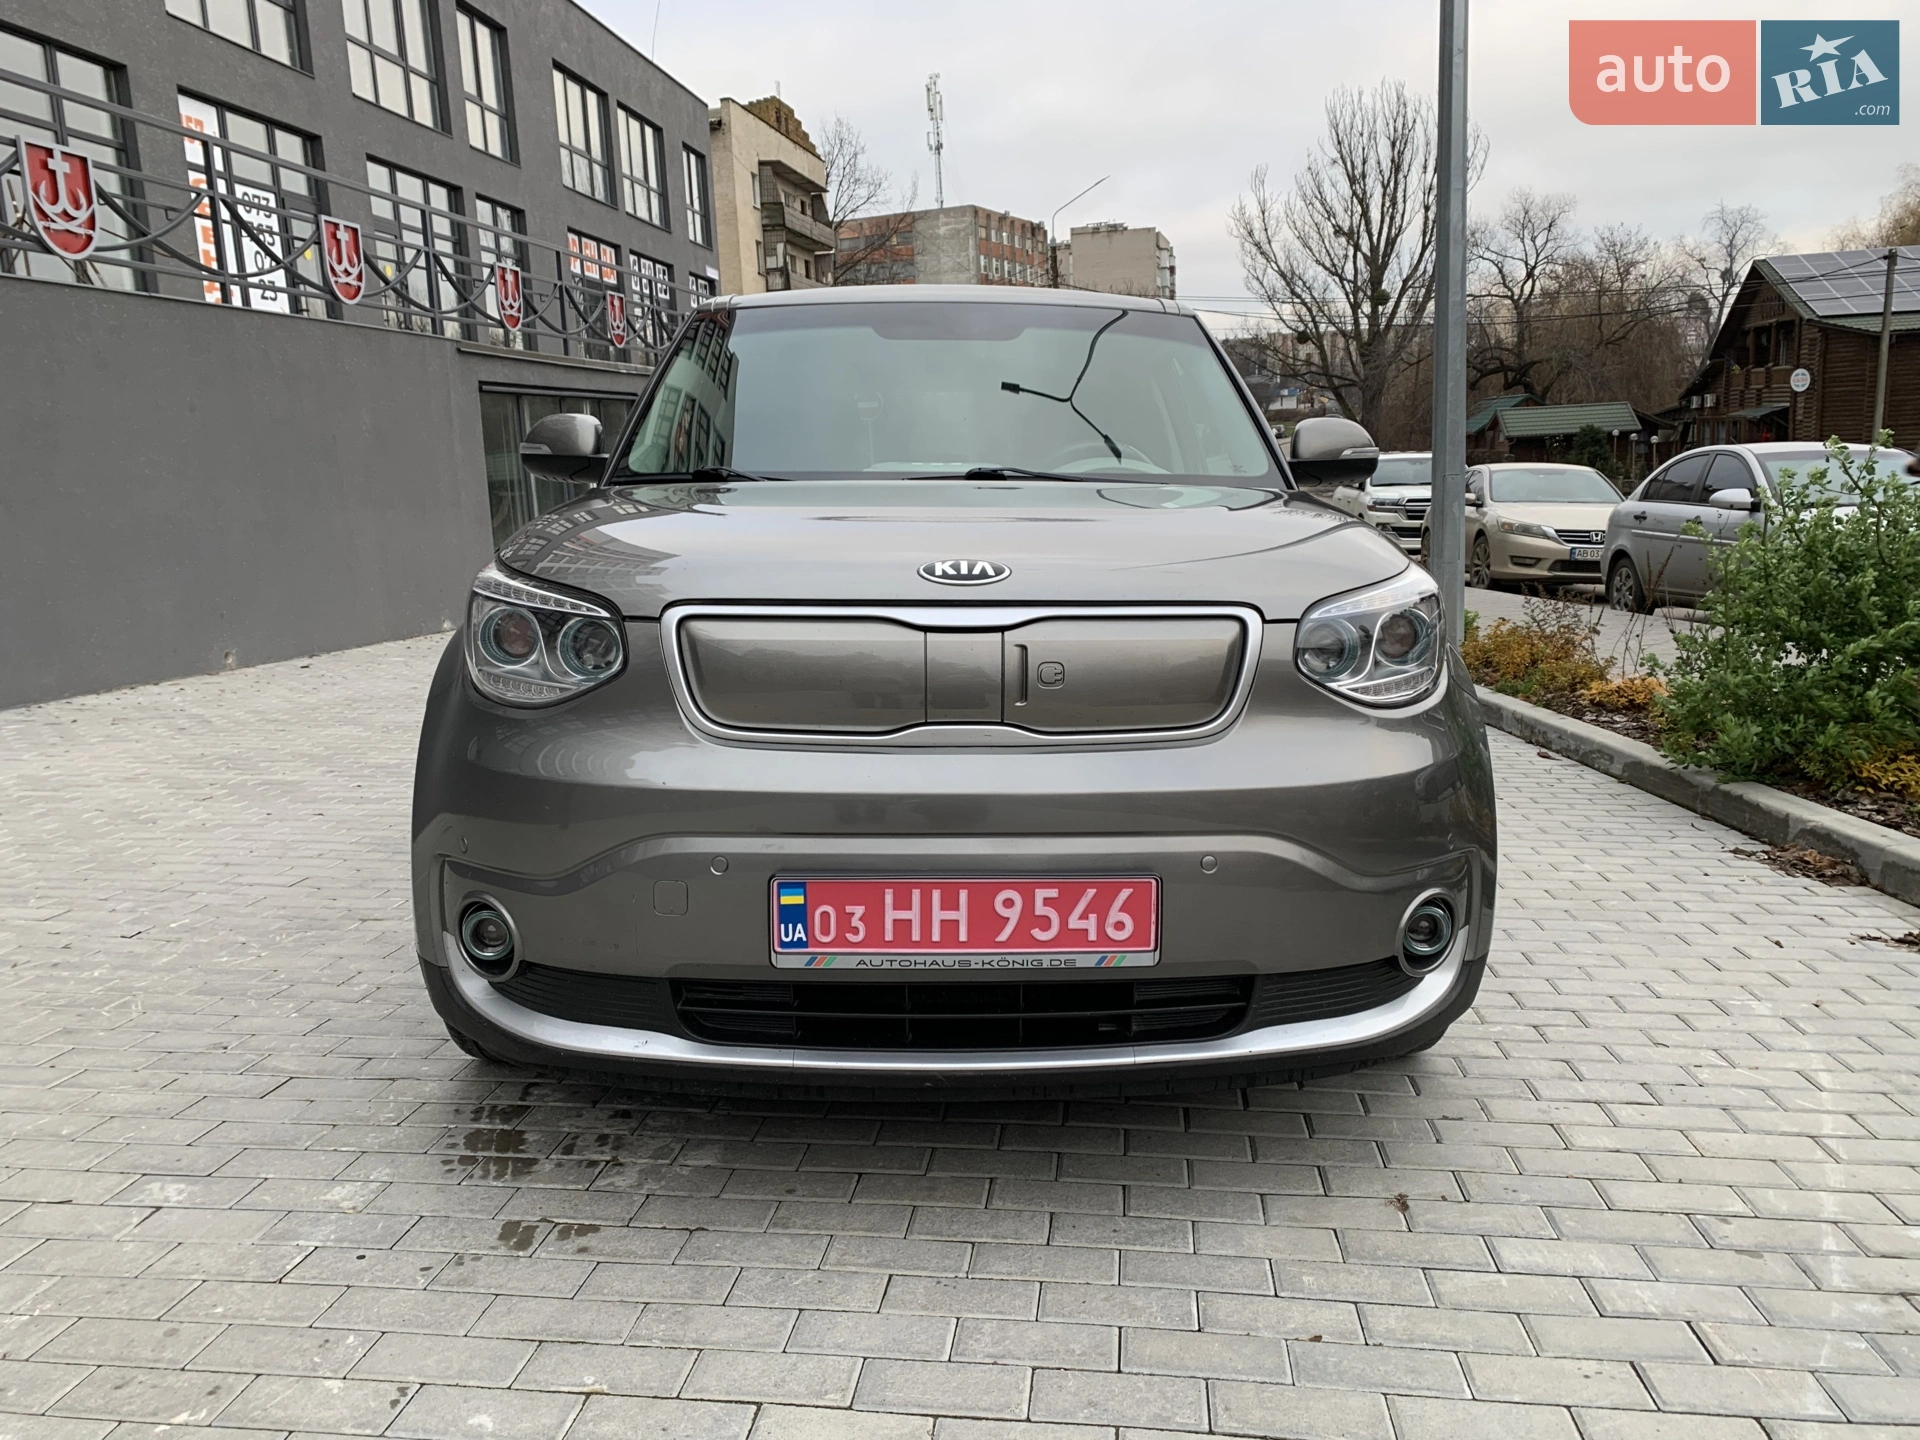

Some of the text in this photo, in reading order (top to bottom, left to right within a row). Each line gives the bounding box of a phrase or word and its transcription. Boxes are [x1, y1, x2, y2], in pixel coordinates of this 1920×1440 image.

[242, 191, 272, 219] 073
[568, 236, 615, 281] РЕНДА
[1590, 549, 1602, 558] 03
[934, 560, 996, 576] KIA
[813, 888, 1135, 944] 03 HH 9546
[780, 923, 807, 943] UA
[855, 956, 1078, 968] AUTOHAUS-KÖNIG.DE
